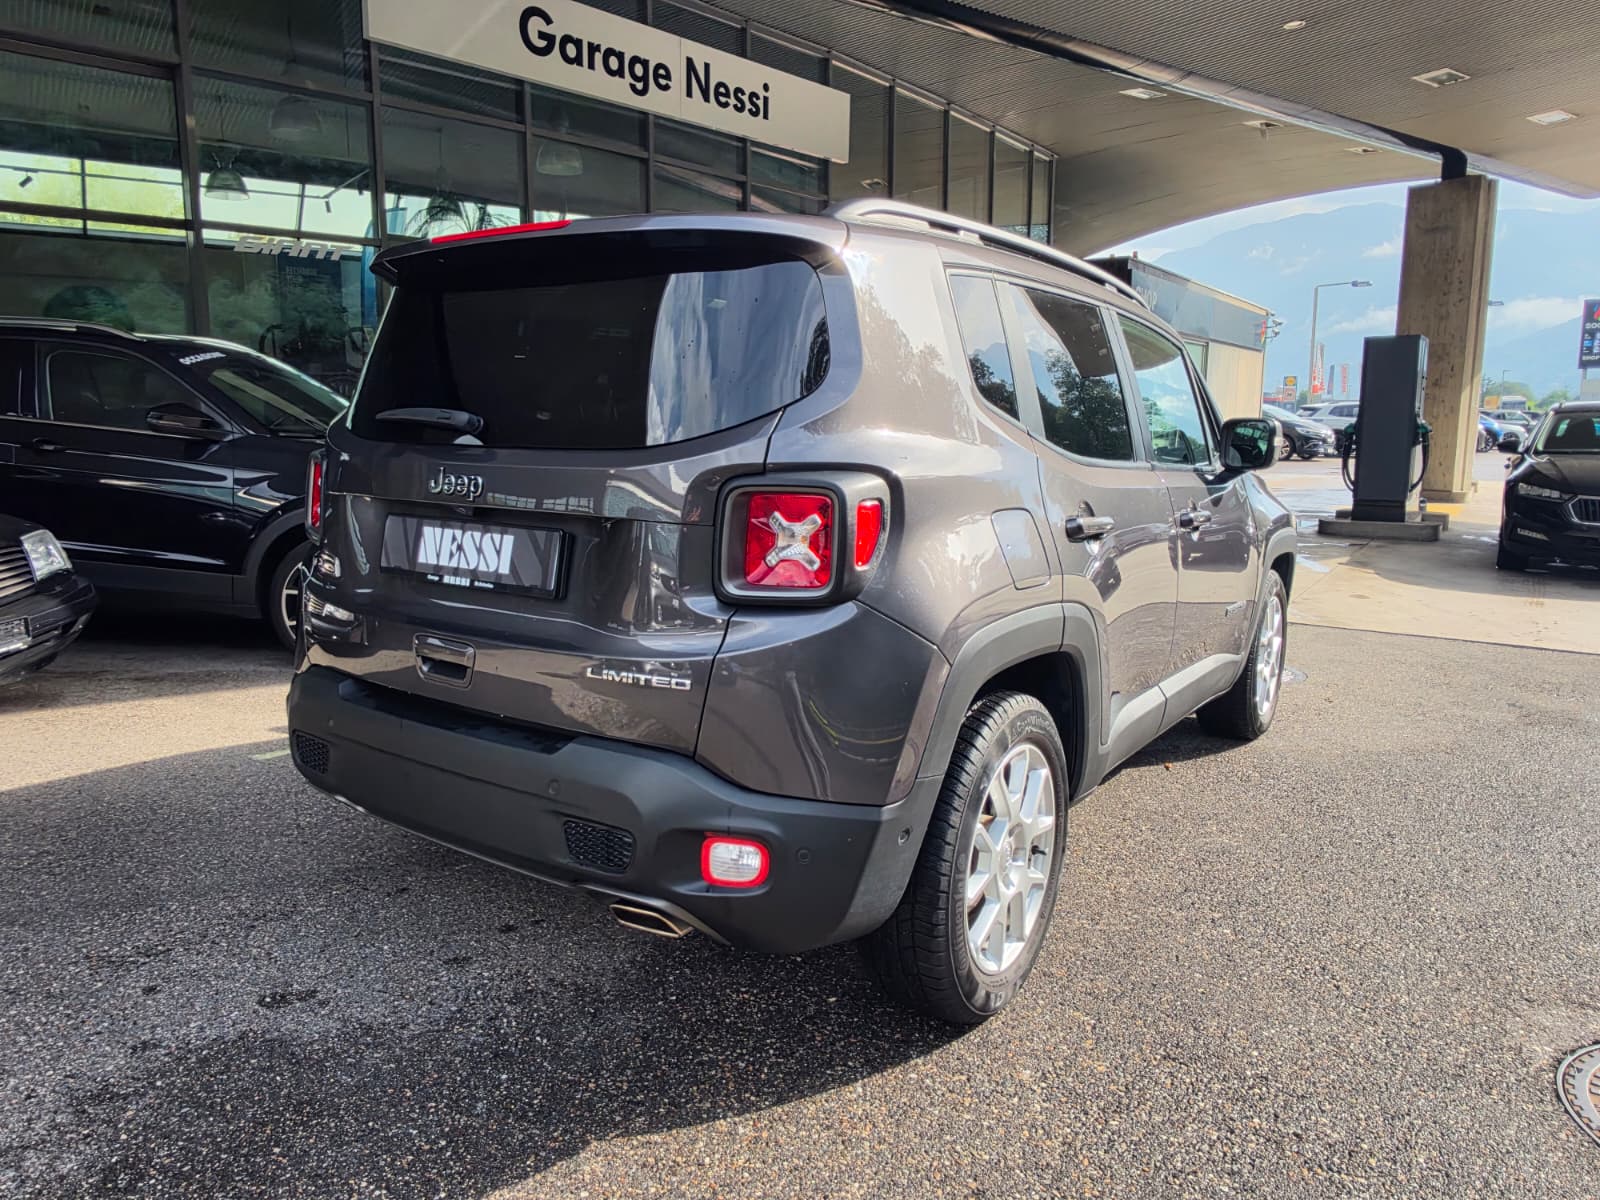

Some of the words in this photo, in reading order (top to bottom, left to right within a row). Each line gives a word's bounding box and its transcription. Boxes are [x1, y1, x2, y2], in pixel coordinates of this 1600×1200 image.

[519, 6, 673, 96] Garage
[685, 56, 770, 120] Nessi
[429, 467, 483, 500] Jeep
[418, 525, 514, 575] NESSI
[586, 667, 692, 691] LIMITED
